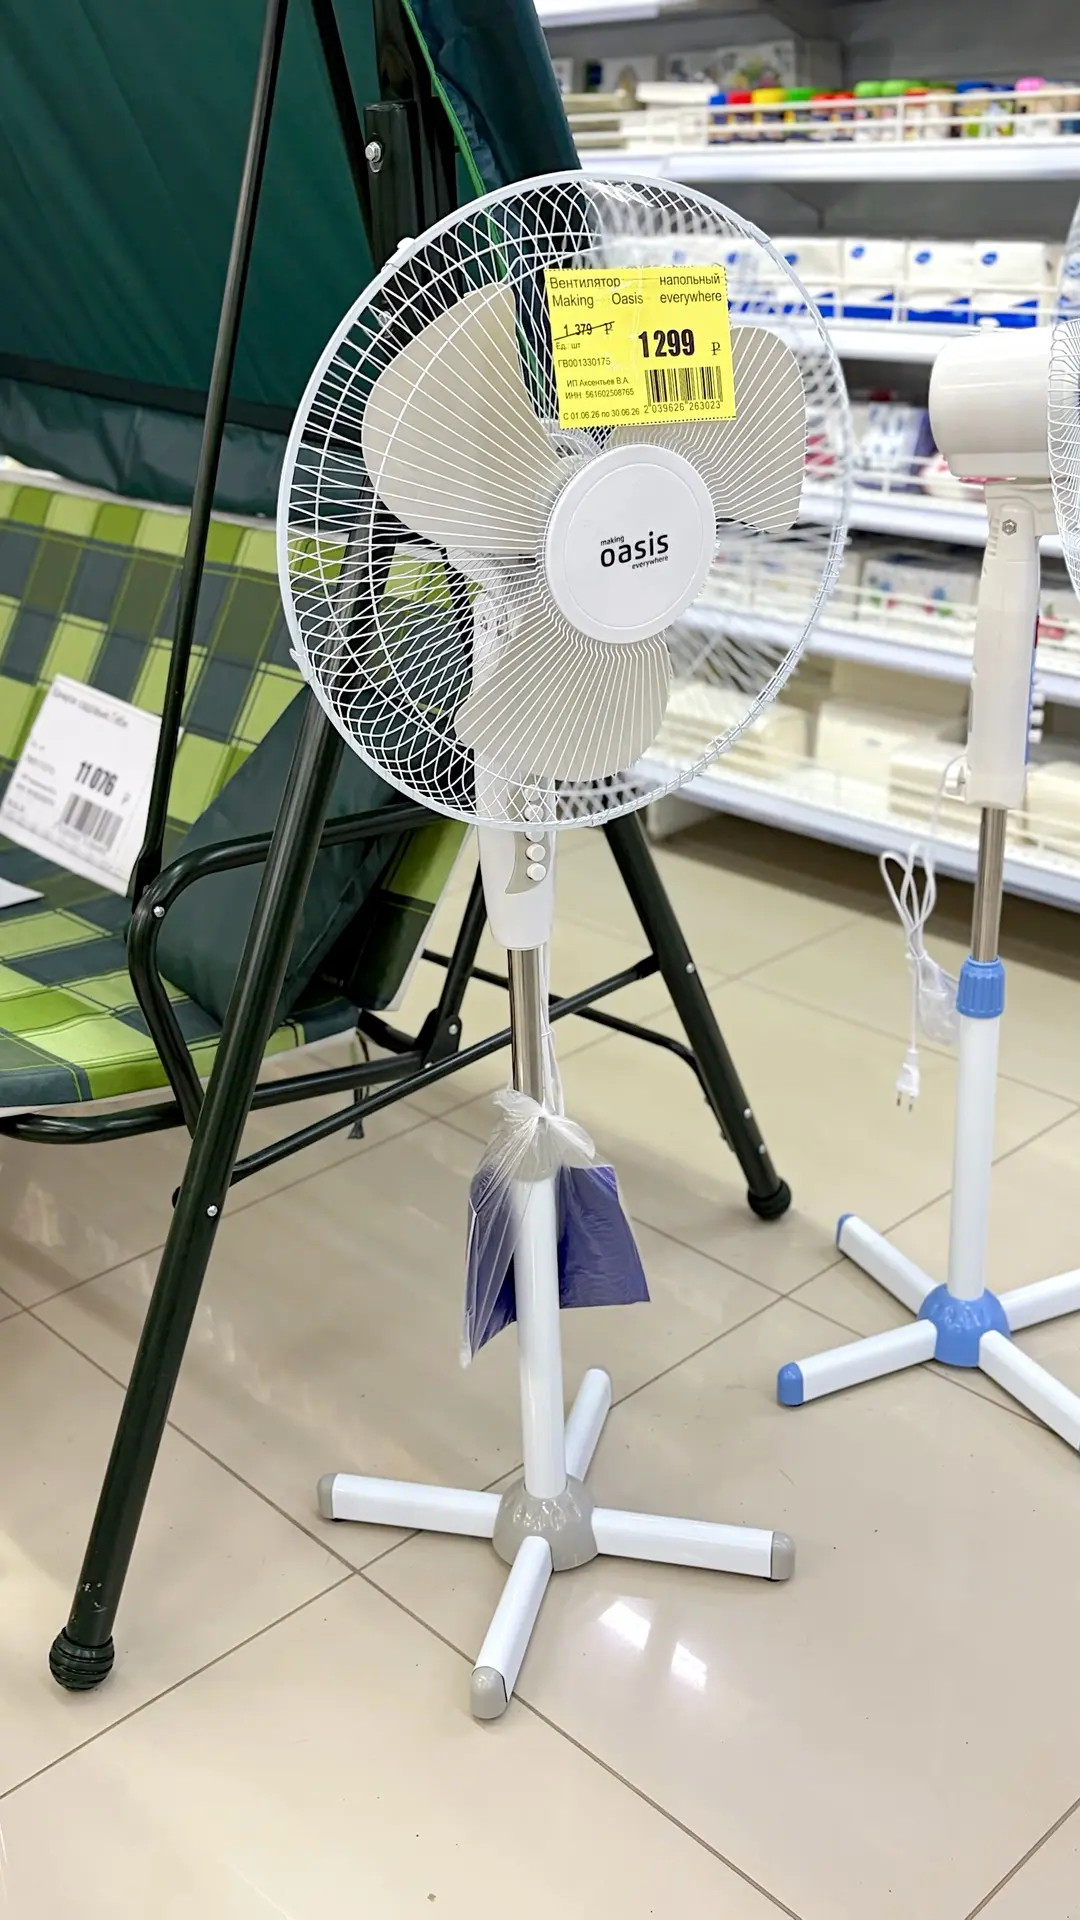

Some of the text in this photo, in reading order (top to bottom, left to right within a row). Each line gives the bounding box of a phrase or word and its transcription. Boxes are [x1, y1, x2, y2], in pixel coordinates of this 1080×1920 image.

[550, 273, 720, 289] Вентилятор напольный
[552, 290, 722, 309] Making Oasis everywhere
[567, 380, 577, 388] ИП
[652, 402, 685, 413] 039626
[689, 400, 721, 411] 263023
[600, 535, 625, 546] making
[600, 530, 669, 568] oasis
[631, 555, 669, 570] everywhere
